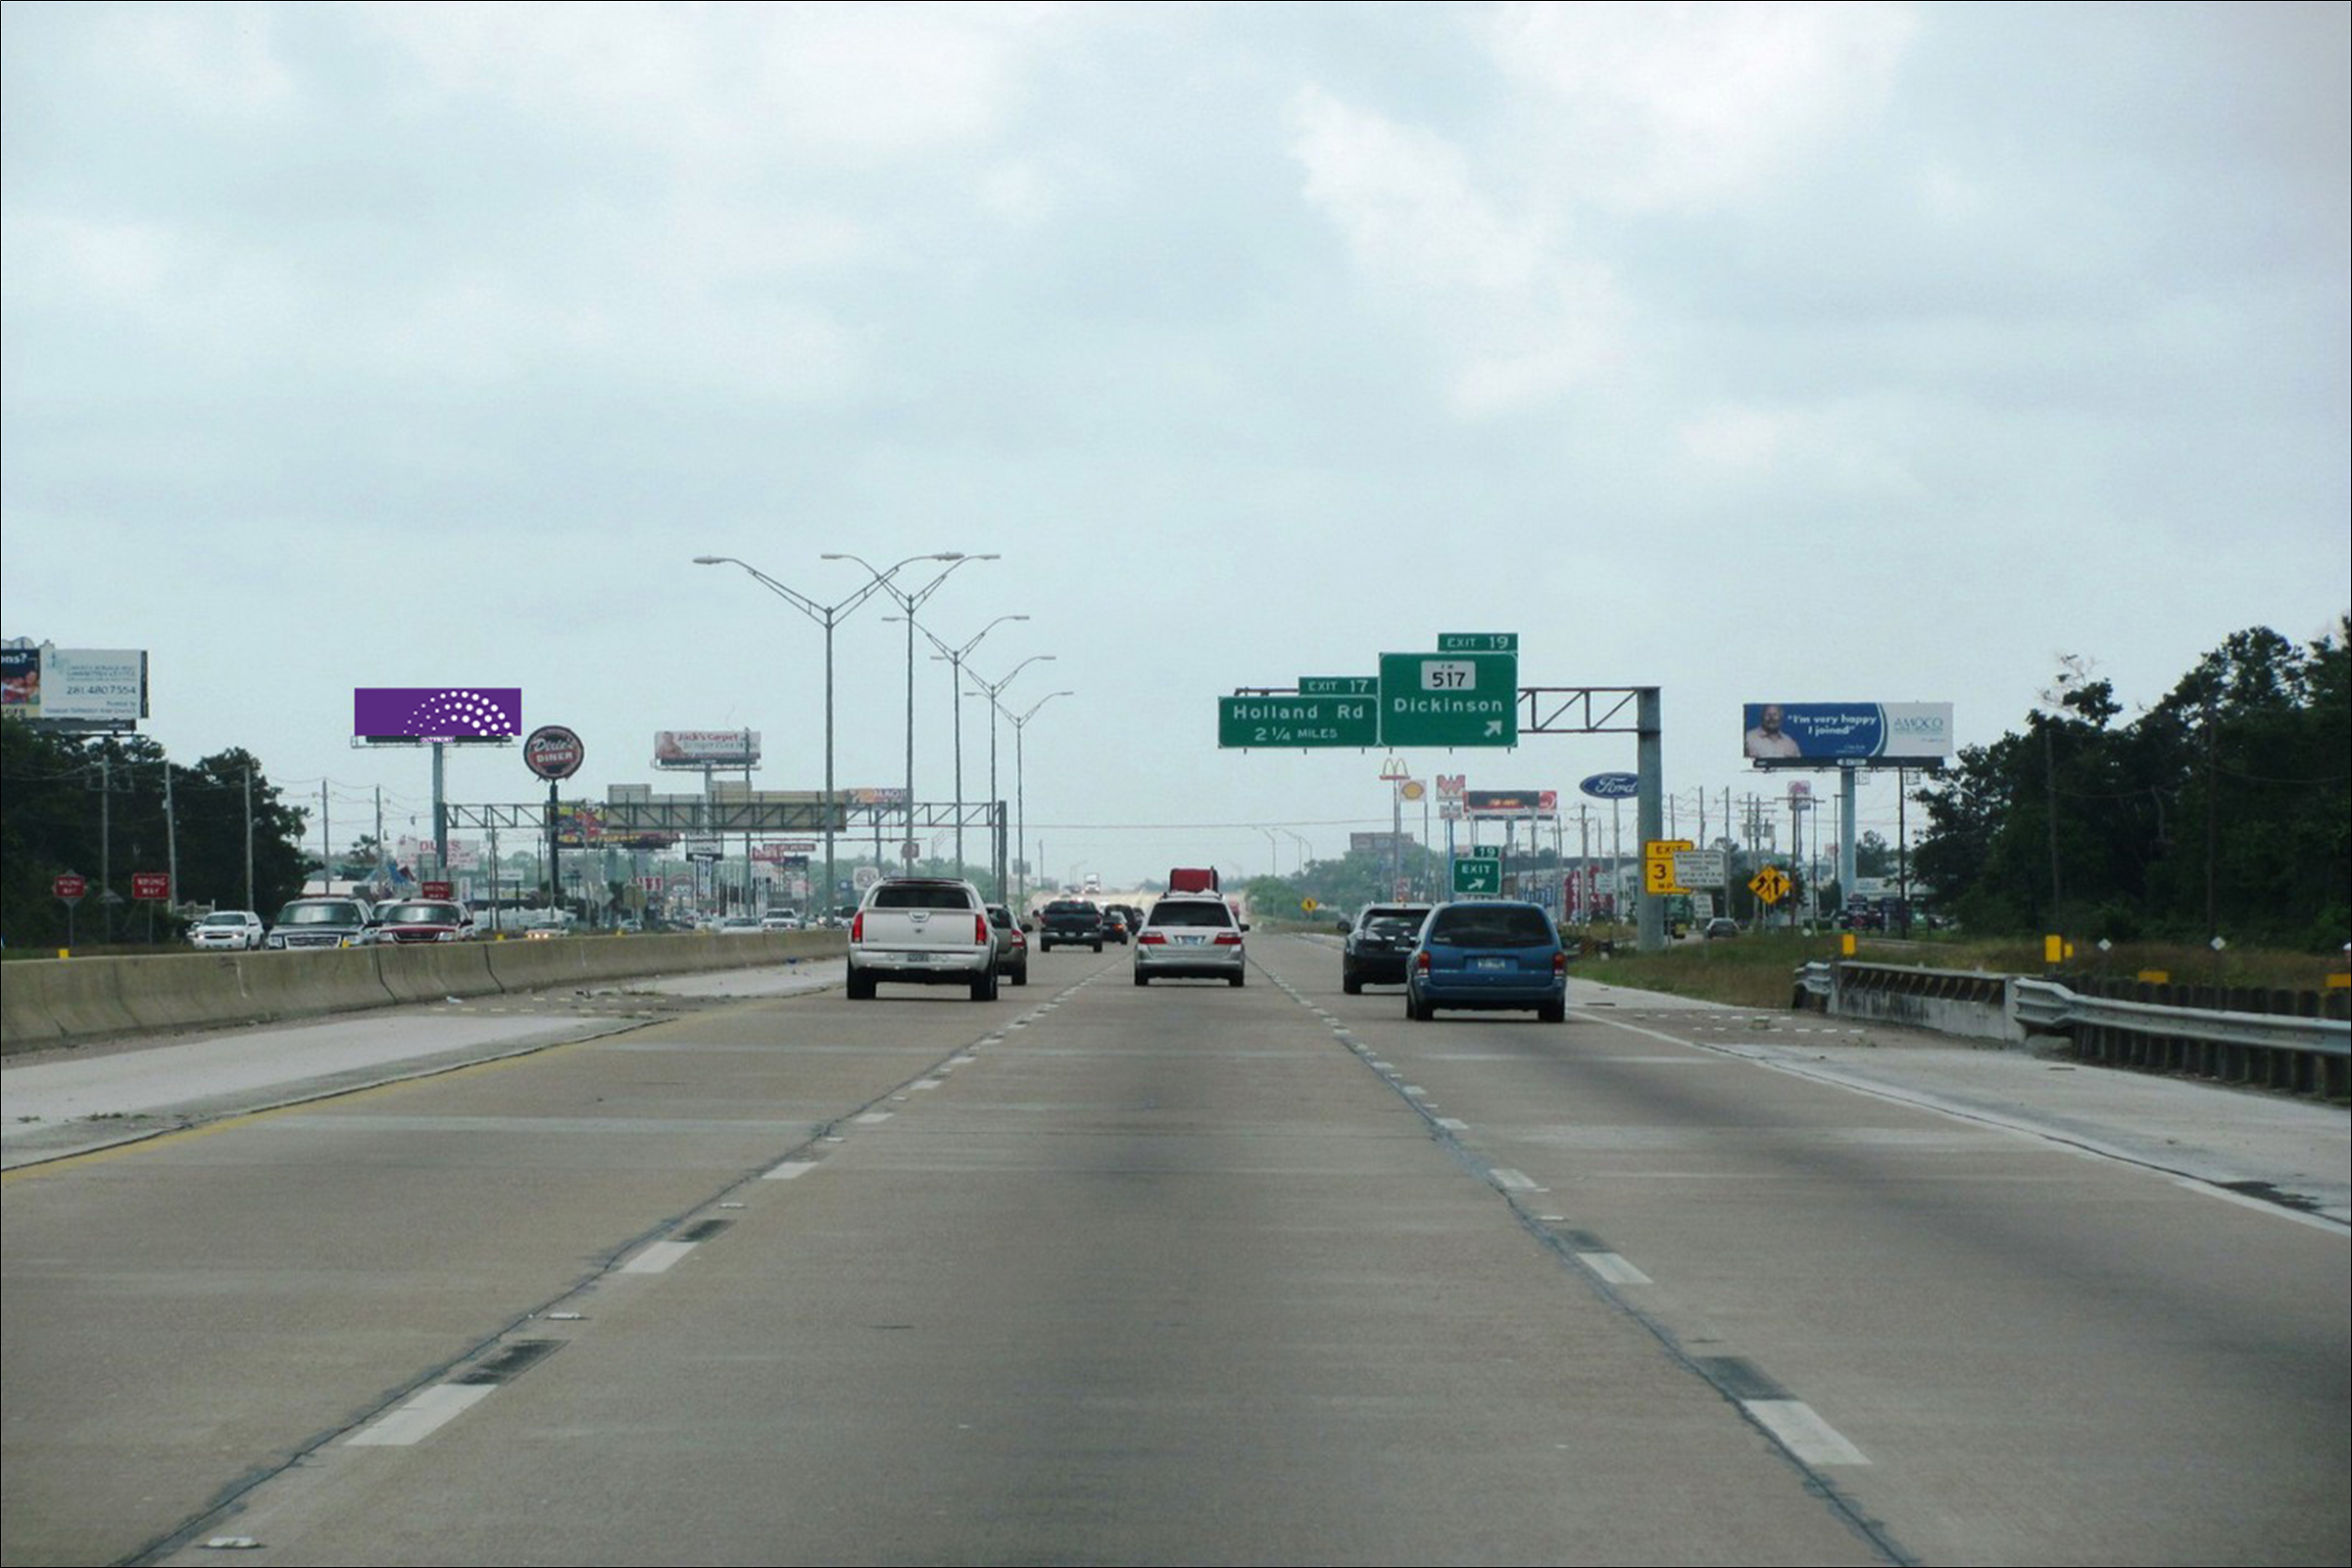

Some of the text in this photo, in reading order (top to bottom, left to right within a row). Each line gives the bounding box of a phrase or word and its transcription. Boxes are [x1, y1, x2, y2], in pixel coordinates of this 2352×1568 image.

[1446, 635, 1509, 649] EXIT 19
[1307, 679, 1369, 693] EXIT 17
[1432, 671, 1466, 688] 517
[1233, 704, 1364, 720] Holland Rd
[1393, 697, 1503, 713] Dickinson
[1813, 715, 1838, 726] very
[1840, 713, 1878, 726] happy
[1254, 727, 1267, 742] 2
[1297, 728, 1339, 739] MILES
[535, 752, 574, 763] DINER
[1594, 777, 1638, 794] Ford
[1479, 846, 1496, 858] 19
[1461, 863, 1491, 874] EXIT
